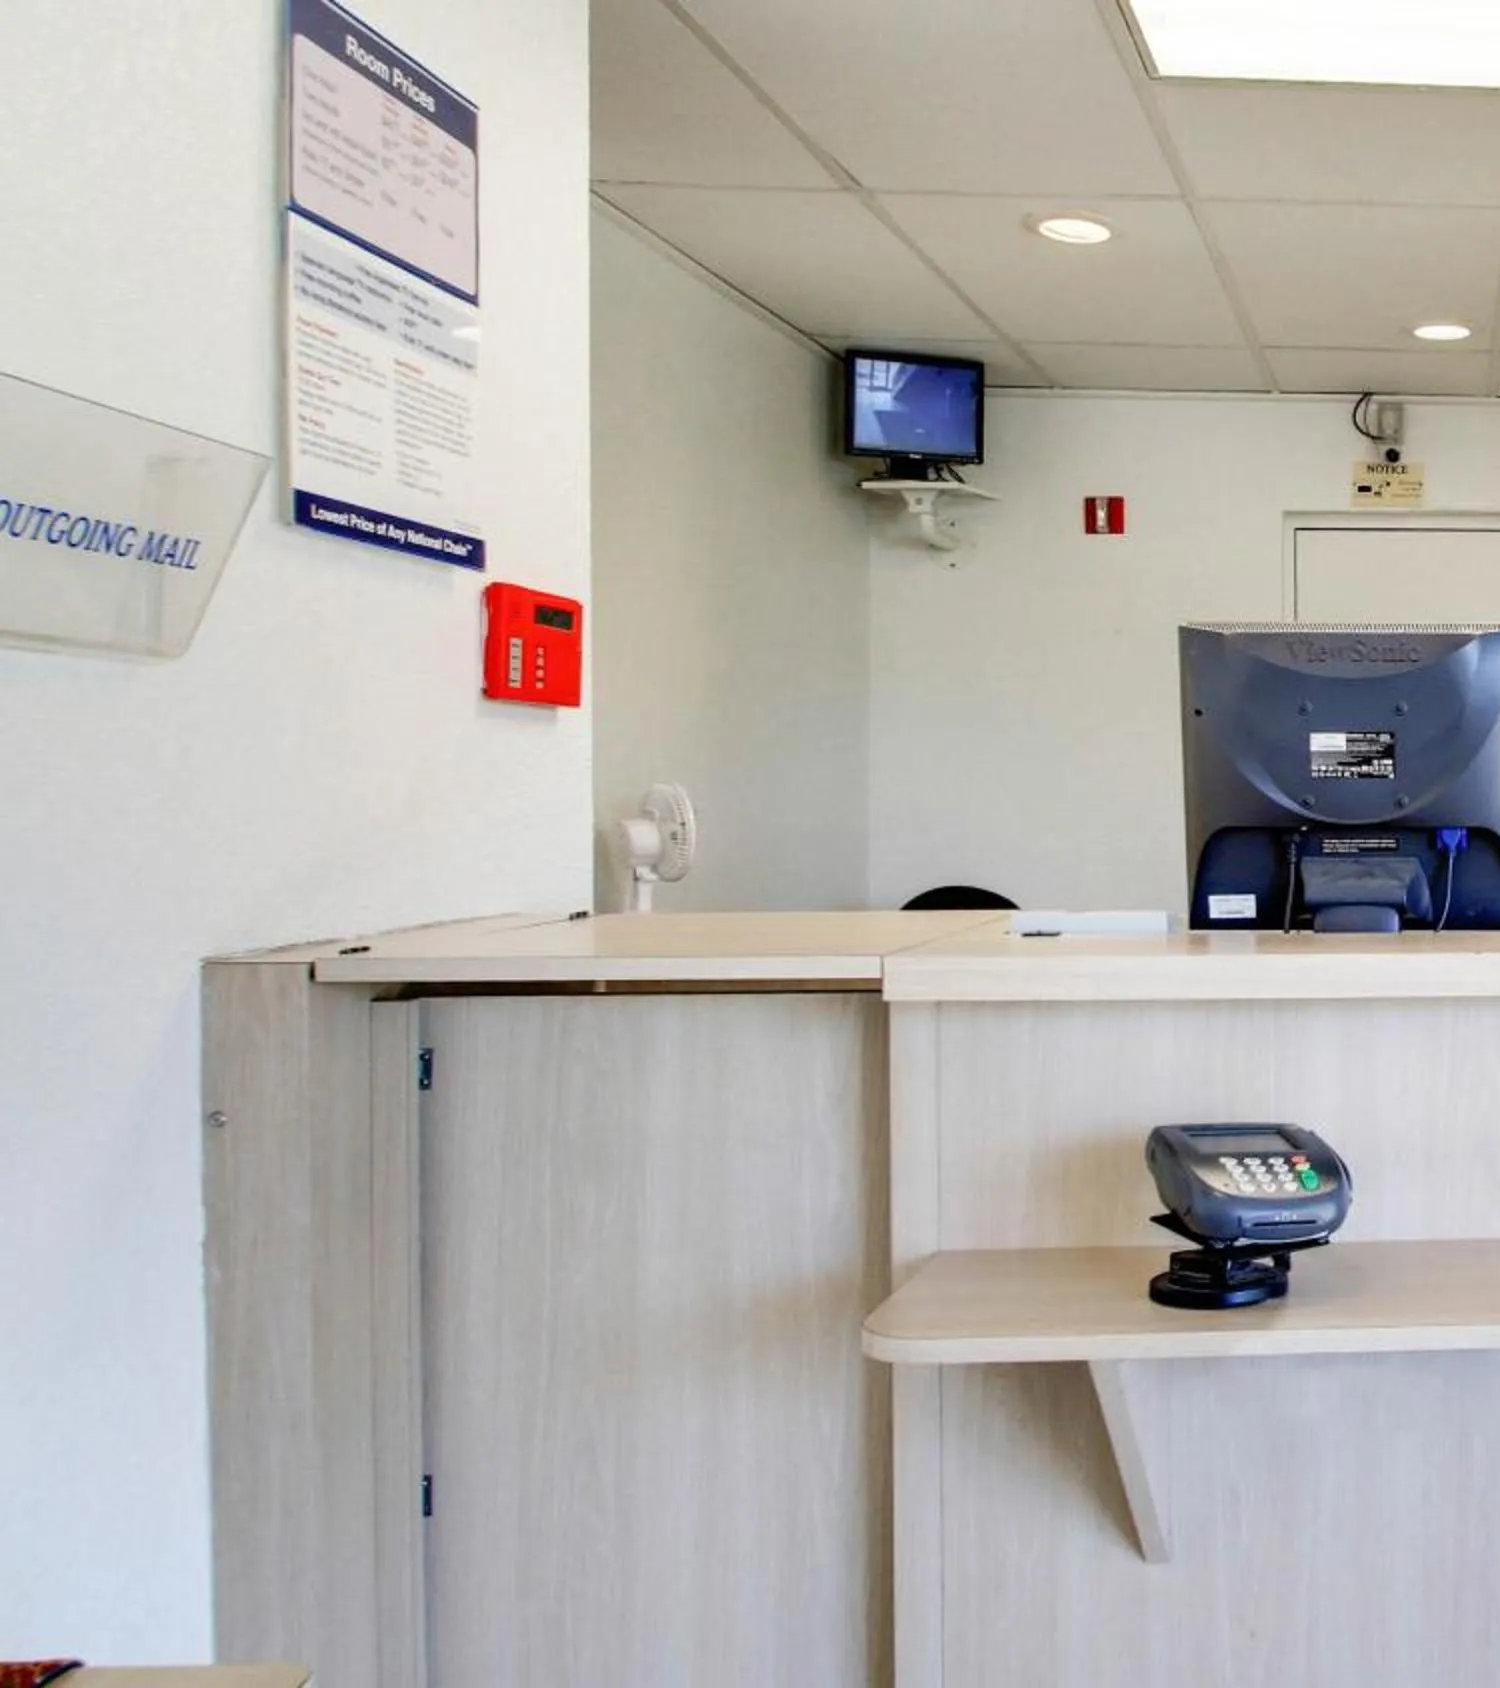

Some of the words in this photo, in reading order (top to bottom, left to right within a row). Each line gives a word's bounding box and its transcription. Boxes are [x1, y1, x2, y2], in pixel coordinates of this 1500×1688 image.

[346, 33, 390, 82] Room
[392, 66, 435, 113] Prices
[1367, 463, 1408, 475] NOTICE
[310, 503, 349, 527] Lowest
[349, 513, 375, 533] Price
[375, 521, 387, 536] of
[387, 523, 407, 544] Any
[407, 529, 443, 551] National
[136, 530, 201, 571] MAIL
[1287, 637, 1421, 663] ViewSonic
